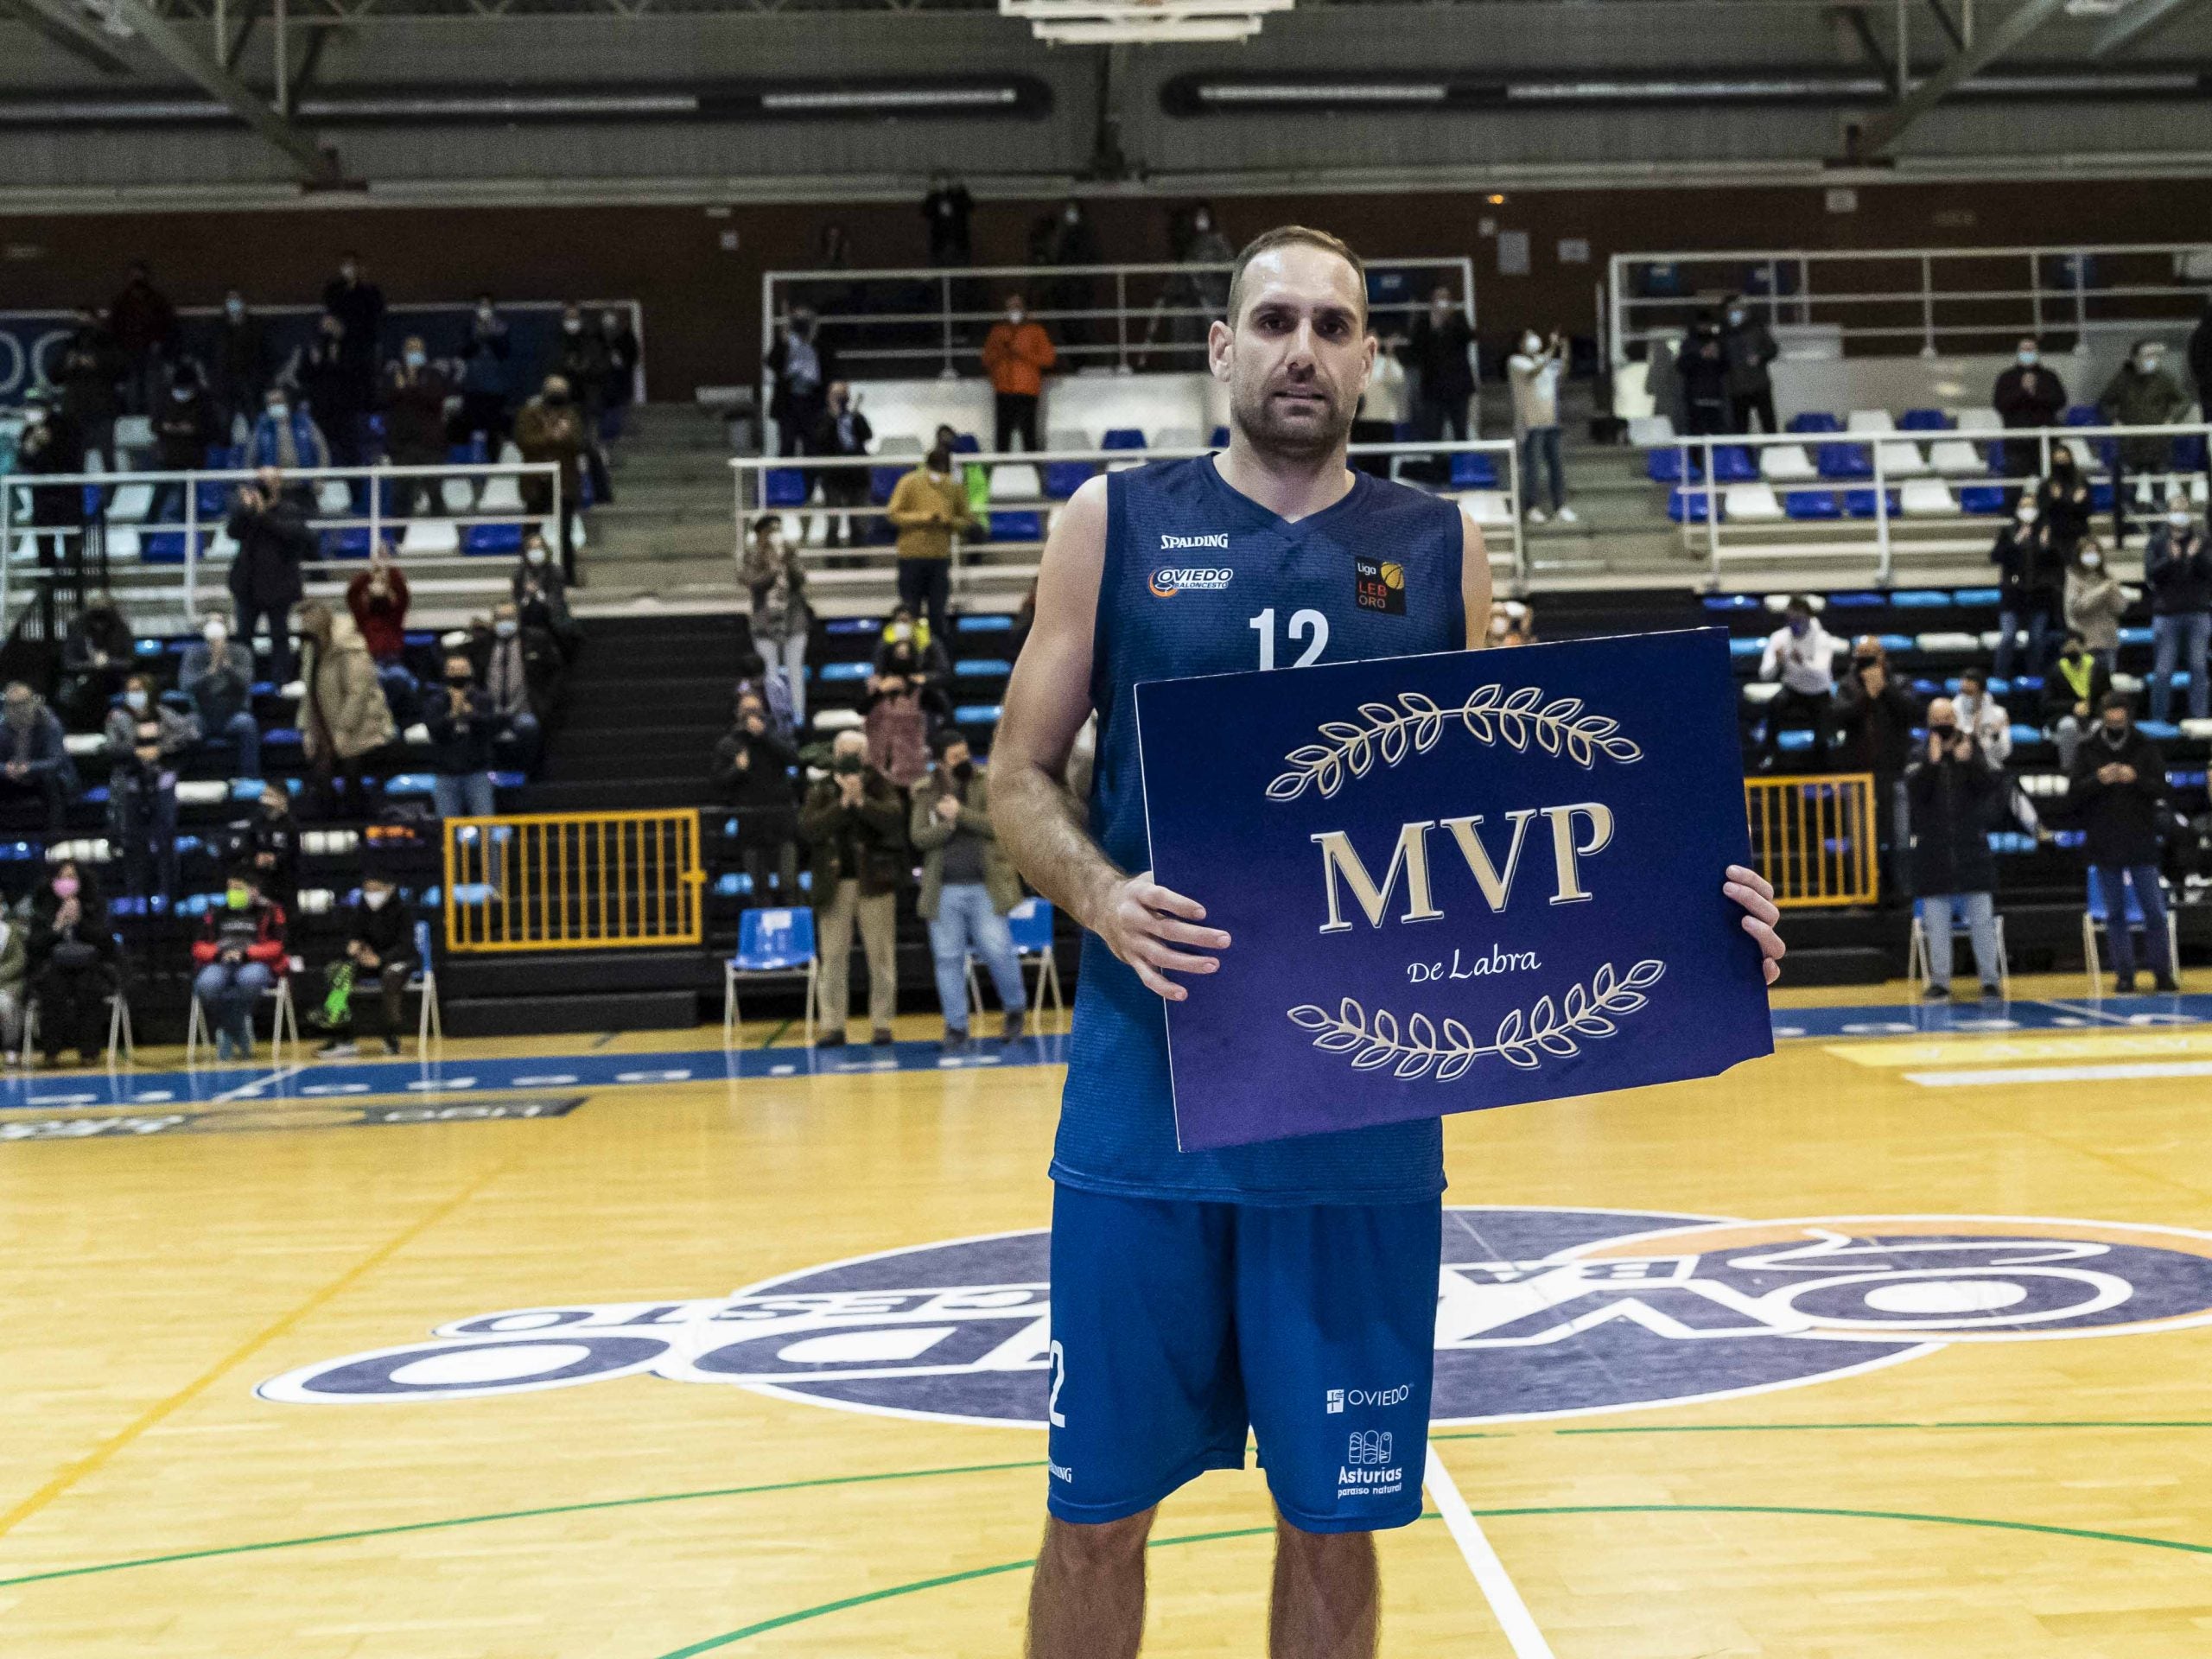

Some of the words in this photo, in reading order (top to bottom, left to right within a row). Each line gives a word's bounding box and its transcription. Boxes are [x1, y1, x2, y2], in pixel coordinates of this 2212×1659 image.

[1160, 533, 1229, 550] SPALDING
[1158, 569, 1233, 583] OVIEDO
[1357, 563, 1376, 575] Liga
[1358, 581, 1387, 598] LEB
[1358, 594, 1386, 609] ORO
[1249, 608, 1329, 671] 12
[1310, 802, 1615, 934] MVP
[1407, 963, 1444, 983] De
[1449, 943, 1541, 979] Labra
[1050, 1339, 1065, 1428] 2
[1348, 1384, 1409, 1407] OVIEDO
[1338, 1465, 1402, 1485] Asturias
[1372, 1482, 1402, 1496] natural
